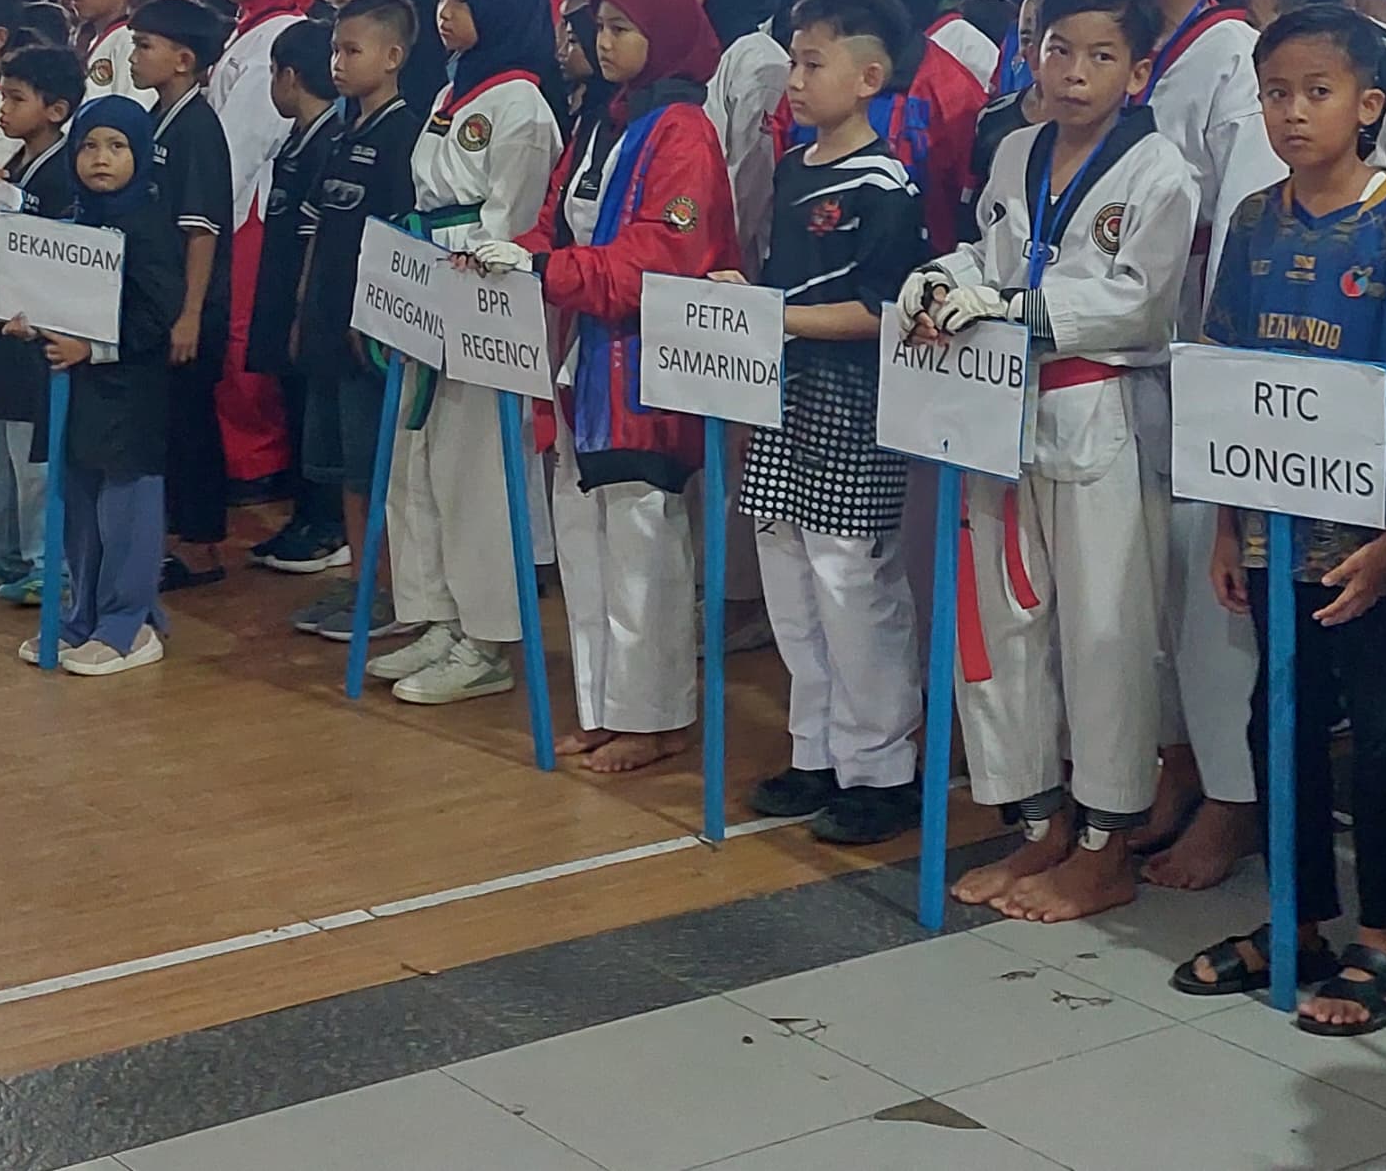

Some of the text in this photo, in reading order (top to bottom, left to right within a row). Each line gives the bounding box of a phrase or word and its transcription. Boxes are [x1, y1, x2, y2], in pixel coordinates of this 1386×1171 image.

[390, 250, 431, 287] BUMI
[477, 287, 513, 318] BPR
[685, 302, 750, 336] PETRA
[460, 332, 541, 371] REGENCY
[658, 345, 780, 387] SAMARINDA
[957, 346, 1024, 389] CLUB
[1254, 380, 1320, 422] RTC
[1209, 440, 1375, 498] LONGIKIS
